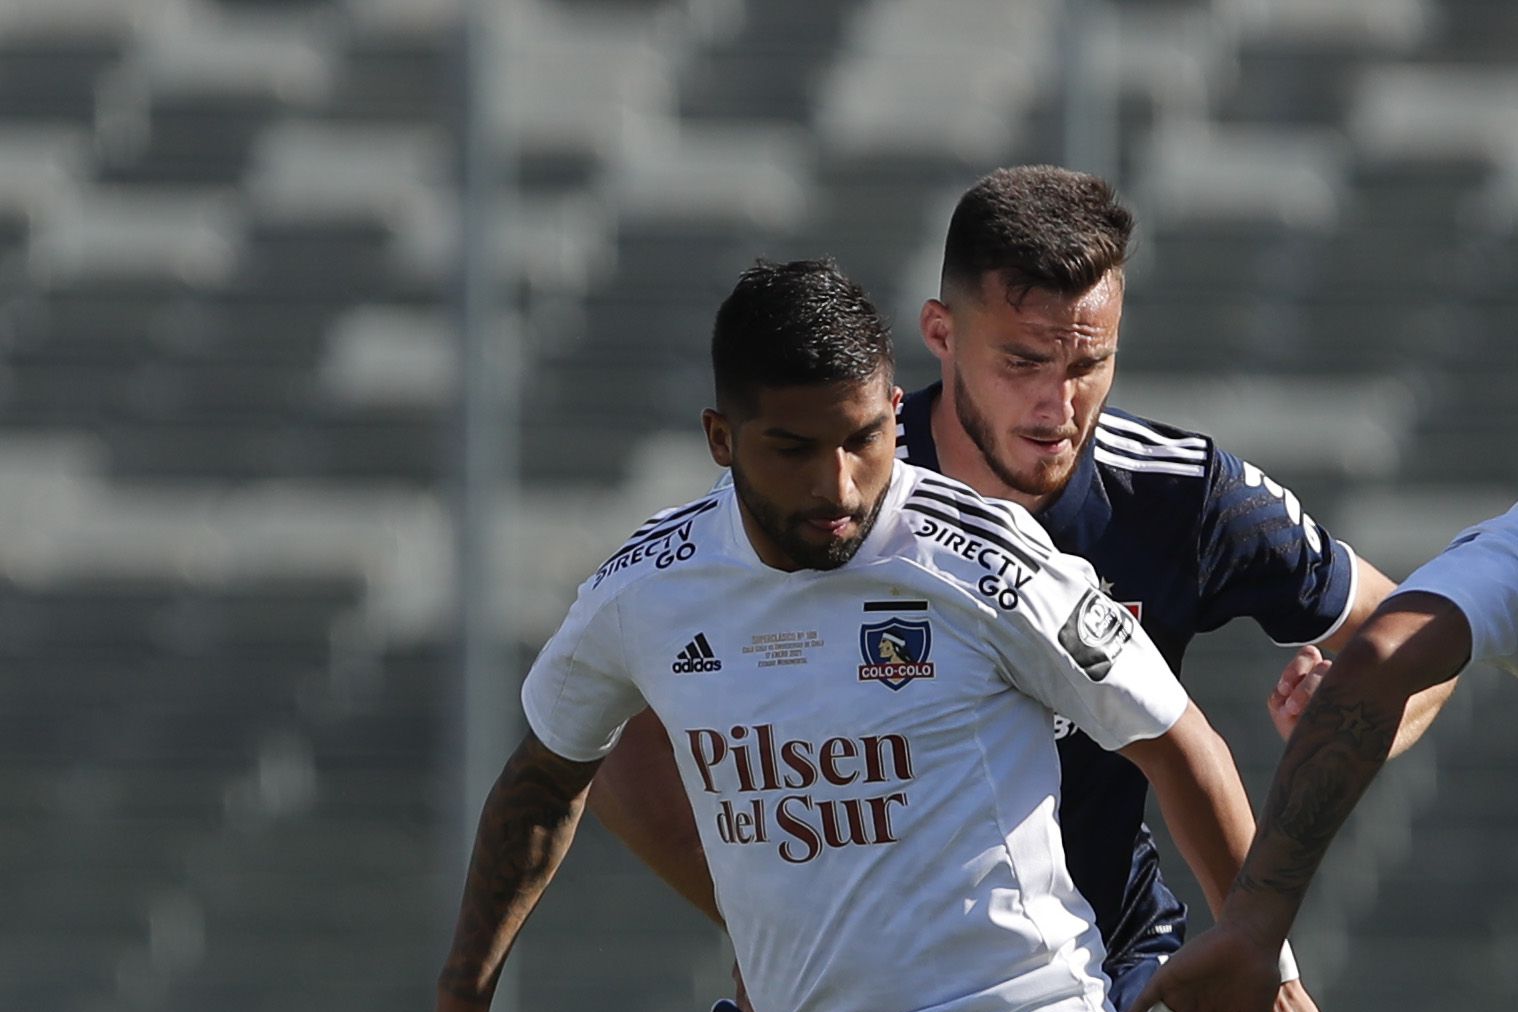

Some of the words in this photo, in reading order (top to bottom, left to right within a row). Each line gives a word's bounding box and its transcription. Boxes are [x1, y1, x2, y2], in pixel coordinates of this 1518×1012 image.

[592, 520, 693, 590] DIRECTV
[655, 542, 696, 569] GO
[913, 519, 1032, 590] DIRECTV
[978, 575, 1019, 610] GO
[672, 656, 722, 674] adidas
[861, 663, 932, 679] COLO-COLO
[685, 724, 915, 793] Pilsen
[717, 799, 770, 844] del
[776, 792, 908, 864] Sur
